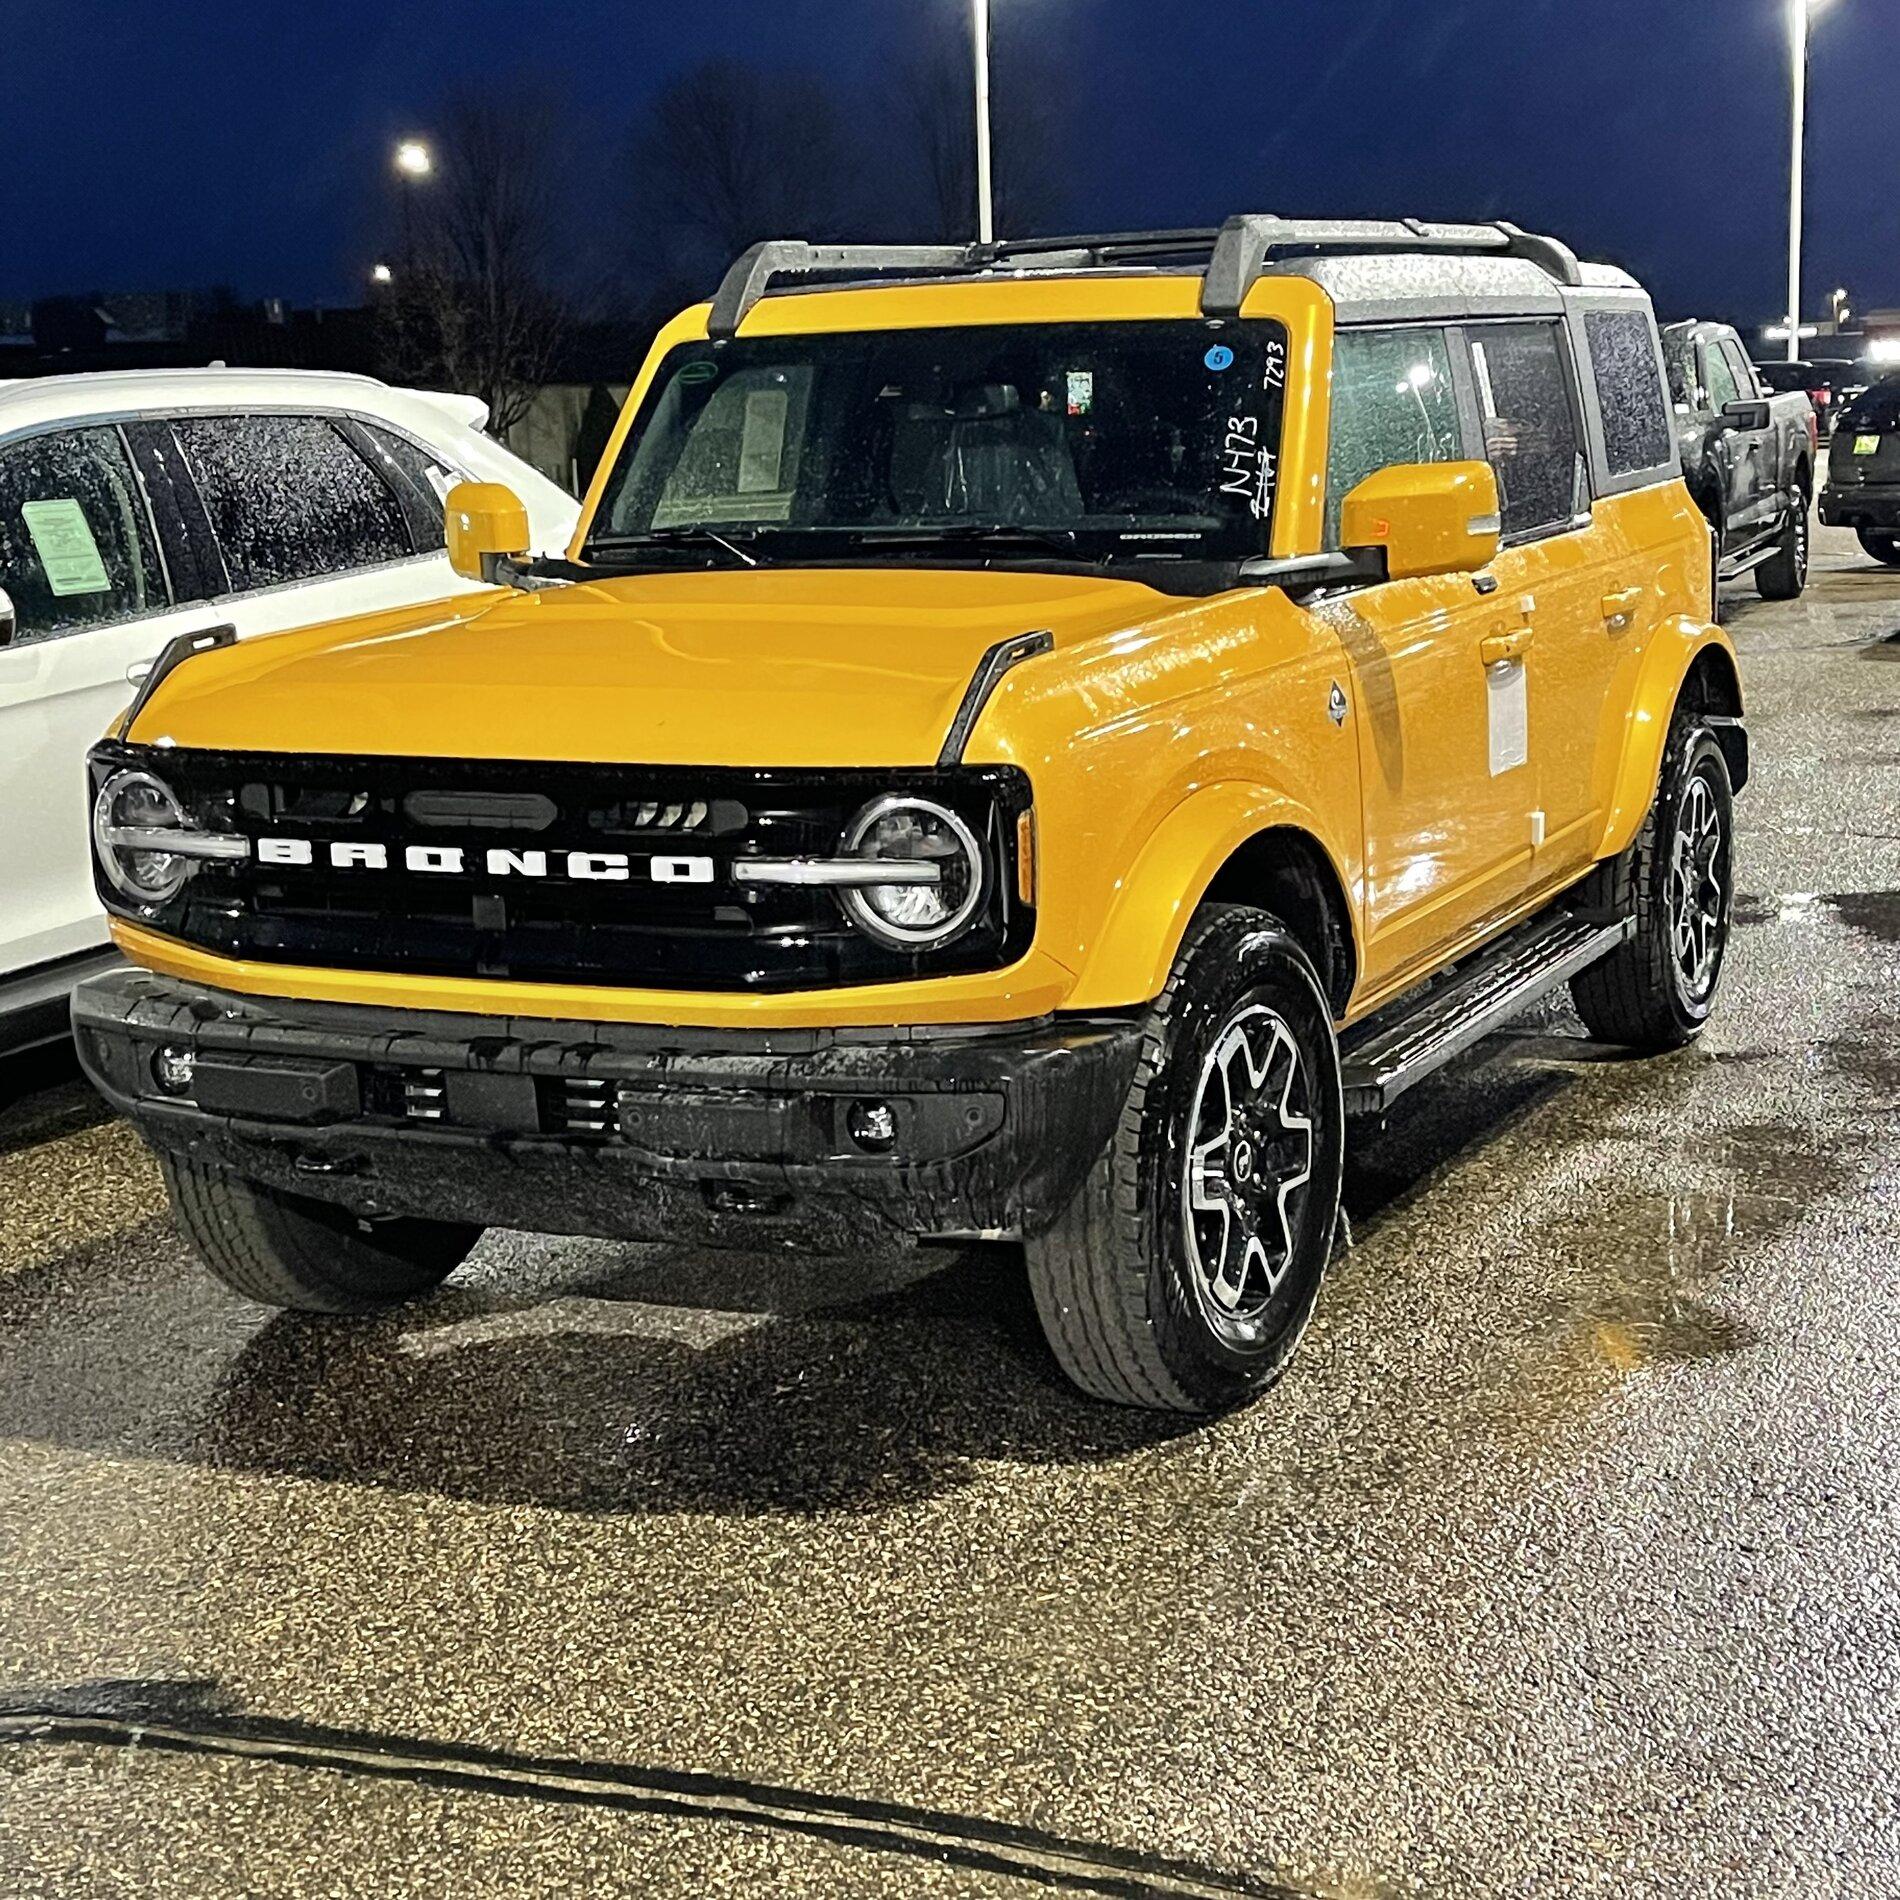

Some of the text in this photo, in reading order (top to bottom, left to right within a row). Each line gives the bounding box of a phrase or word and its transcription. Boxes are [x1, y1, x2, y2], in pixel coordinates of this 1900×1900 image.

[1263, 341, 1285, 391] 7293
[1219, 416, 1258, 497] N473
[257, 837, 715, 883] BRONCO
